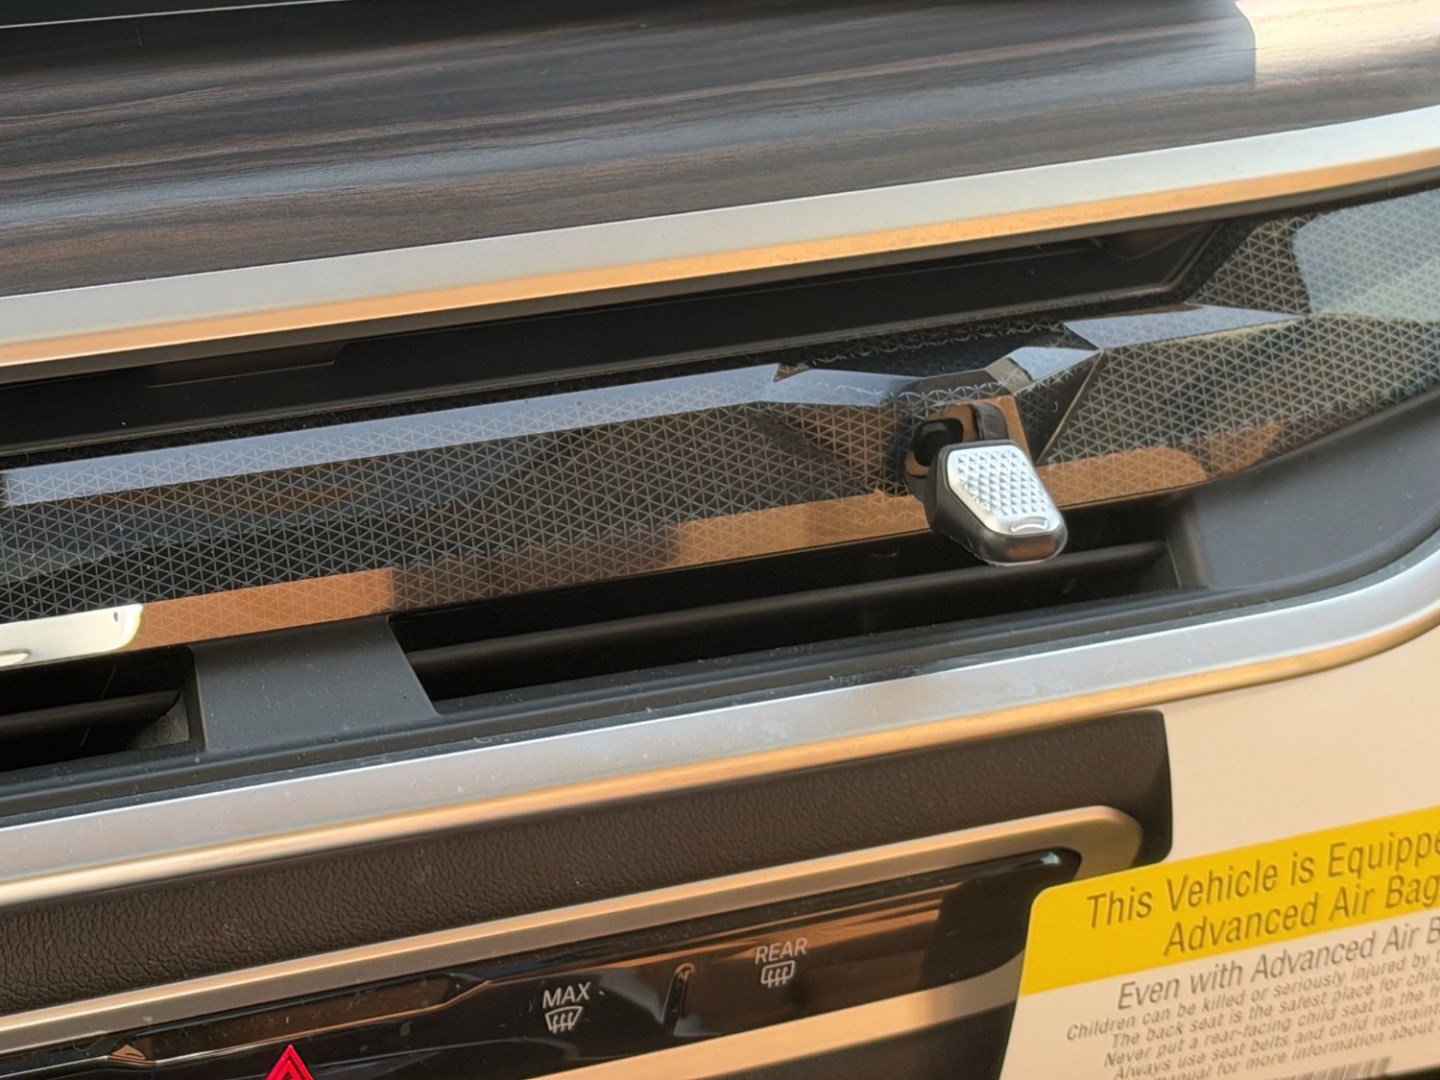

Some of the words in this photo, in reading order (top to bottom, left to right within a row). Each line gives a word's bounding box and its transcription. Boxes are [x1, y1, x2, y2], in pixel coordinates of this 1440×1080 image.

[1086, 887, 1152, 929] This
[1166, 859, 1278, 911] Vehicle
[1290, 852, 1315, 886] is
[1163, 892, 1319, 956] Advanced
[1328, 883, 1376, 921] Air
[755, 937, 808, 965] REAR
[1117, 977, 1180, 1010] Even
[1190, 960, 1243, 995] with
[1250, 930, 1377, 982] Advanced
[1381, 923, 1421, 955] Air
[541, 981, 592, 1009] MAX
[1066, 1016, 1136, 1041] Children
[1142, 1008, 1171, 1026] can
[1176, 1002, 1197, 1018] be
[1201, 989, 1246, 1012] killed
[1251, 988, 1269, 1003] or
[1273, 970, 1345, 999] seriously
[1351, 955, 1407, 982] injured
[1411, 951, 1431, 970] by
[1104, 1048, 1153, 1069] Never
[1156, 1039, 1185, 1059] put
[1188, 1037, 1199, 1050] a
[1203, 1016, 1292, 1047] rear-facing
[1297, 1007, 1337, 1028] child
[1341, 999, 1375, 1019] seat
[1379, 995, 1394, 1009] in
[1399, 989, 1424, 1006] the
[1112, 1032, 1140, 1049] The
[1146, 1021, 1184, 1043] back
[1189, 1013, 1224, 1032] seat
[1228, 1009, 1242, 1024] is
[1248, 1004, 1273, 1020] the
[1279, 991, 1328, 1014] safest
[1332, 983, 1374, 1005] place
[1380, 976, 1403, 993] for
[1113, 1059, 1172, 1080] Always
[1177, 1051, 1206, 1069] use
[1210, 1041, 1247, 1062] seat
[1249, 1034, 1290, 1054] belts
[1293, 1025, 1326, 1046] and
[1329, 1017, 1370, 1038] child
[1244, 1051, 1288, 1070] more
[1291, 1030, 1385, 1062] information
[1389, 1019, 1435, 1041] about
